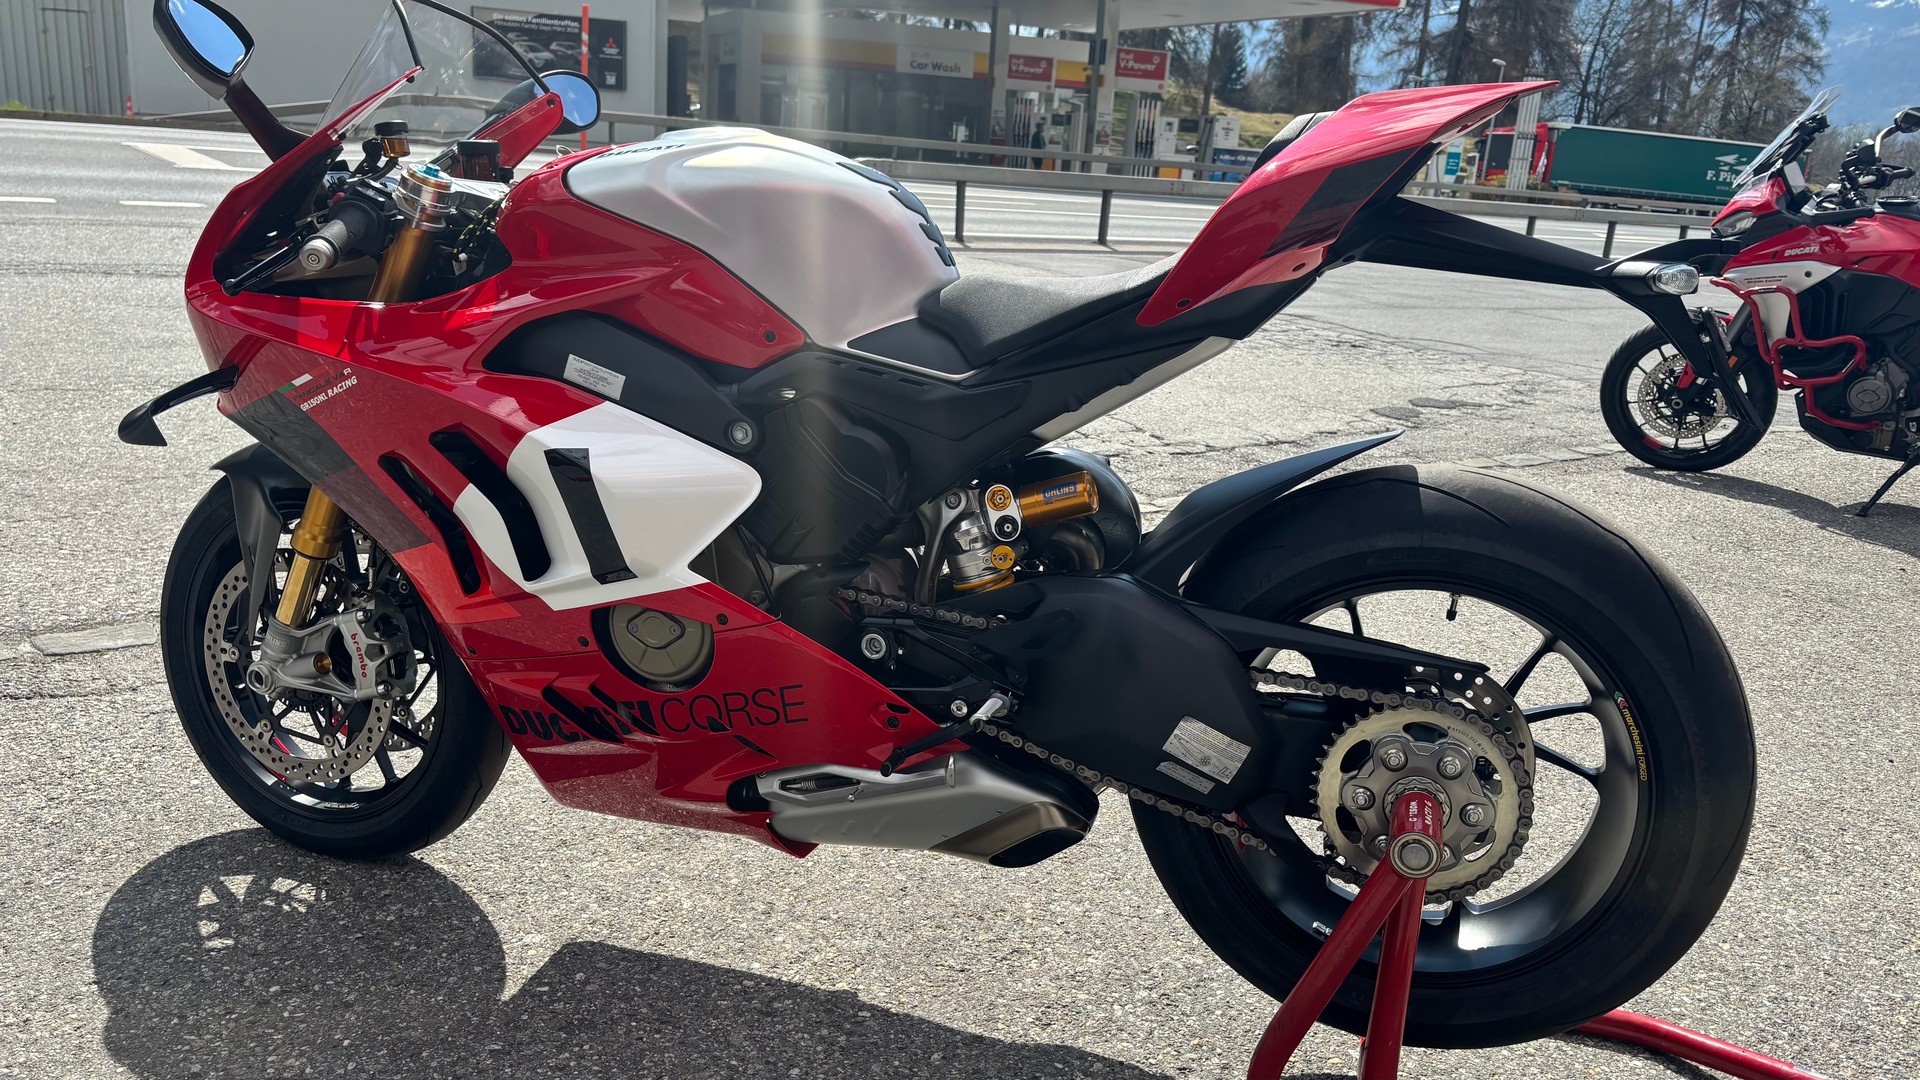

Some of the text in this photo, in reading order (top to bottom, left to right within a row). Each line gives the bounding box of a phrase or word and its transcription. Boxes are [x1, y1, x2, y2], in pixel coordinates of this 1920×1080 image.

[910, 60, 961, 73] Car Wash
[1011, 64, 1045, 74] V-Power
[1119, 59, 1157, 71] V-Power
[596, 143, 687, 159] DUCATI
[1706, 170, 1716, 181] F.
[1784, 246, 1820, 257] DUCATI
[300, 375, 358, 412] GRISONI RACING
[351, 632, 368, 679] brembo
[659, 684, 809, 733] CORSE
[1622, 708, 1648, 781] marchesini FORGED
